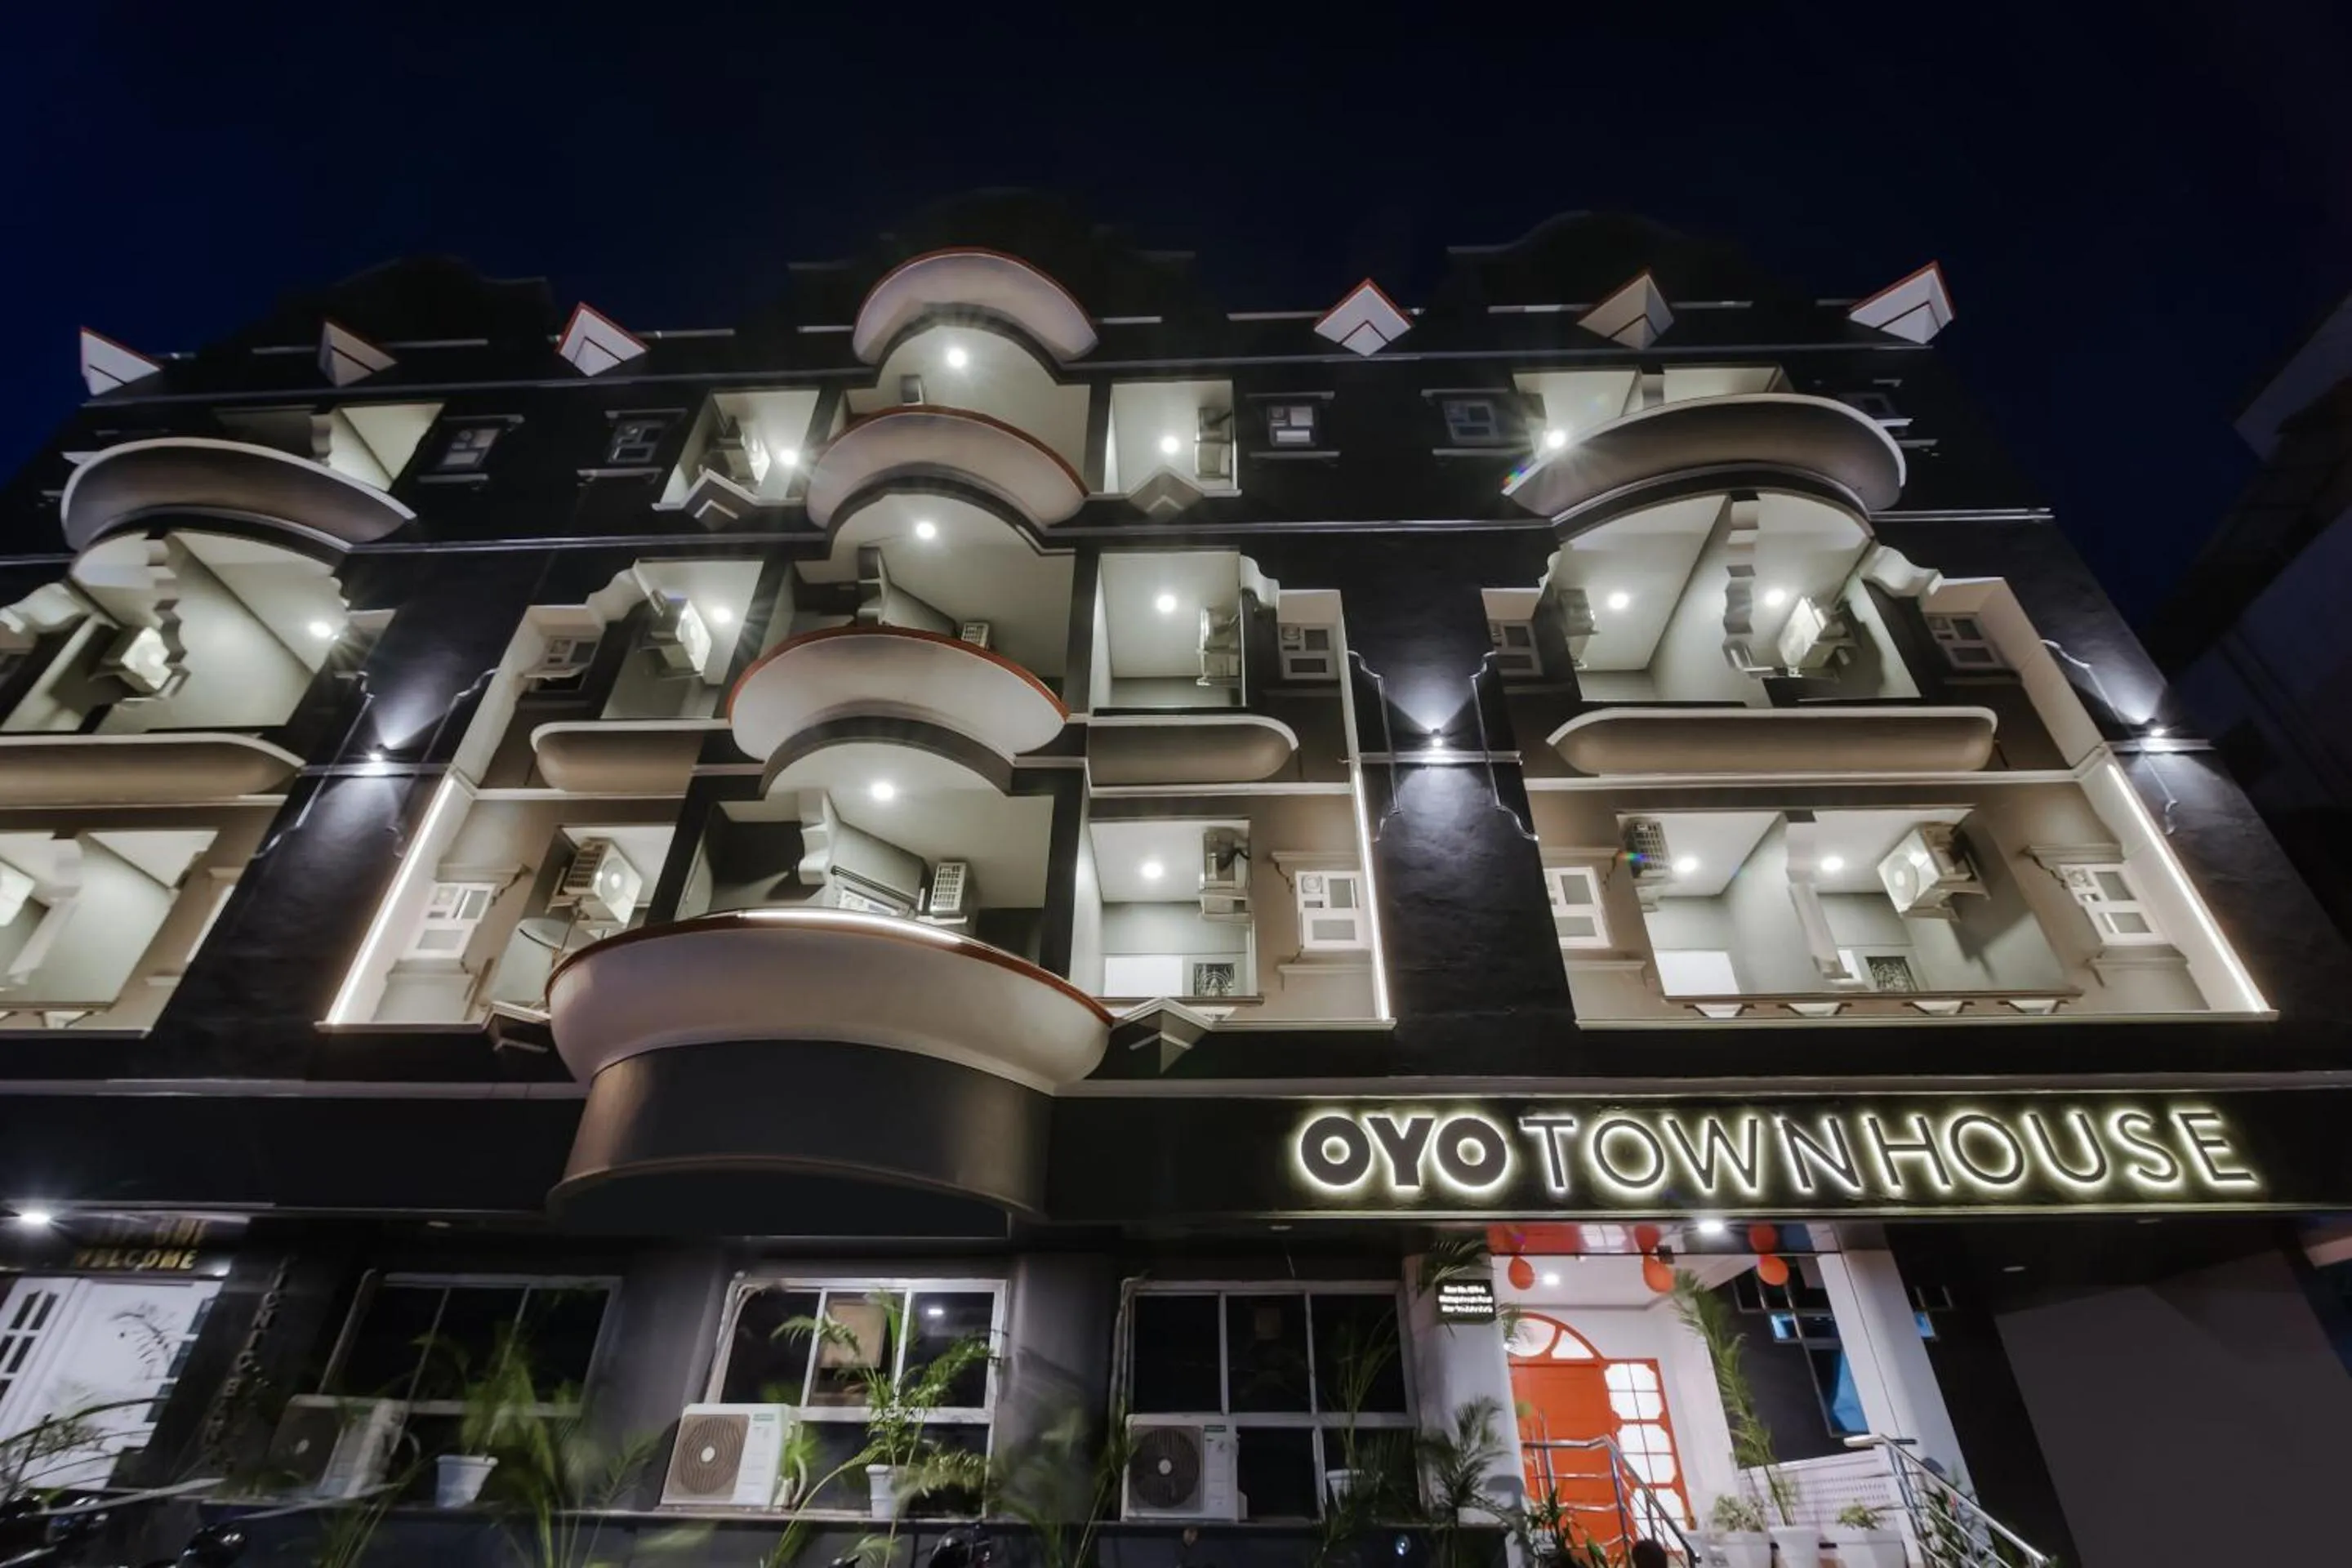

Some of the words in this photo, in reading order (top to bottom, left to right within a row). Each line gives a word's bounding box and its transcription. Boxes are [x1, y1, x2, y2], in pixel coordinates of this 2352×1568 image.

[1300, 1114, 1508, 1187] OYO
[1519, 1109, 2258, 1191] TOWNHOUSE
[74, 1249, 199, 1270] WELCOME
